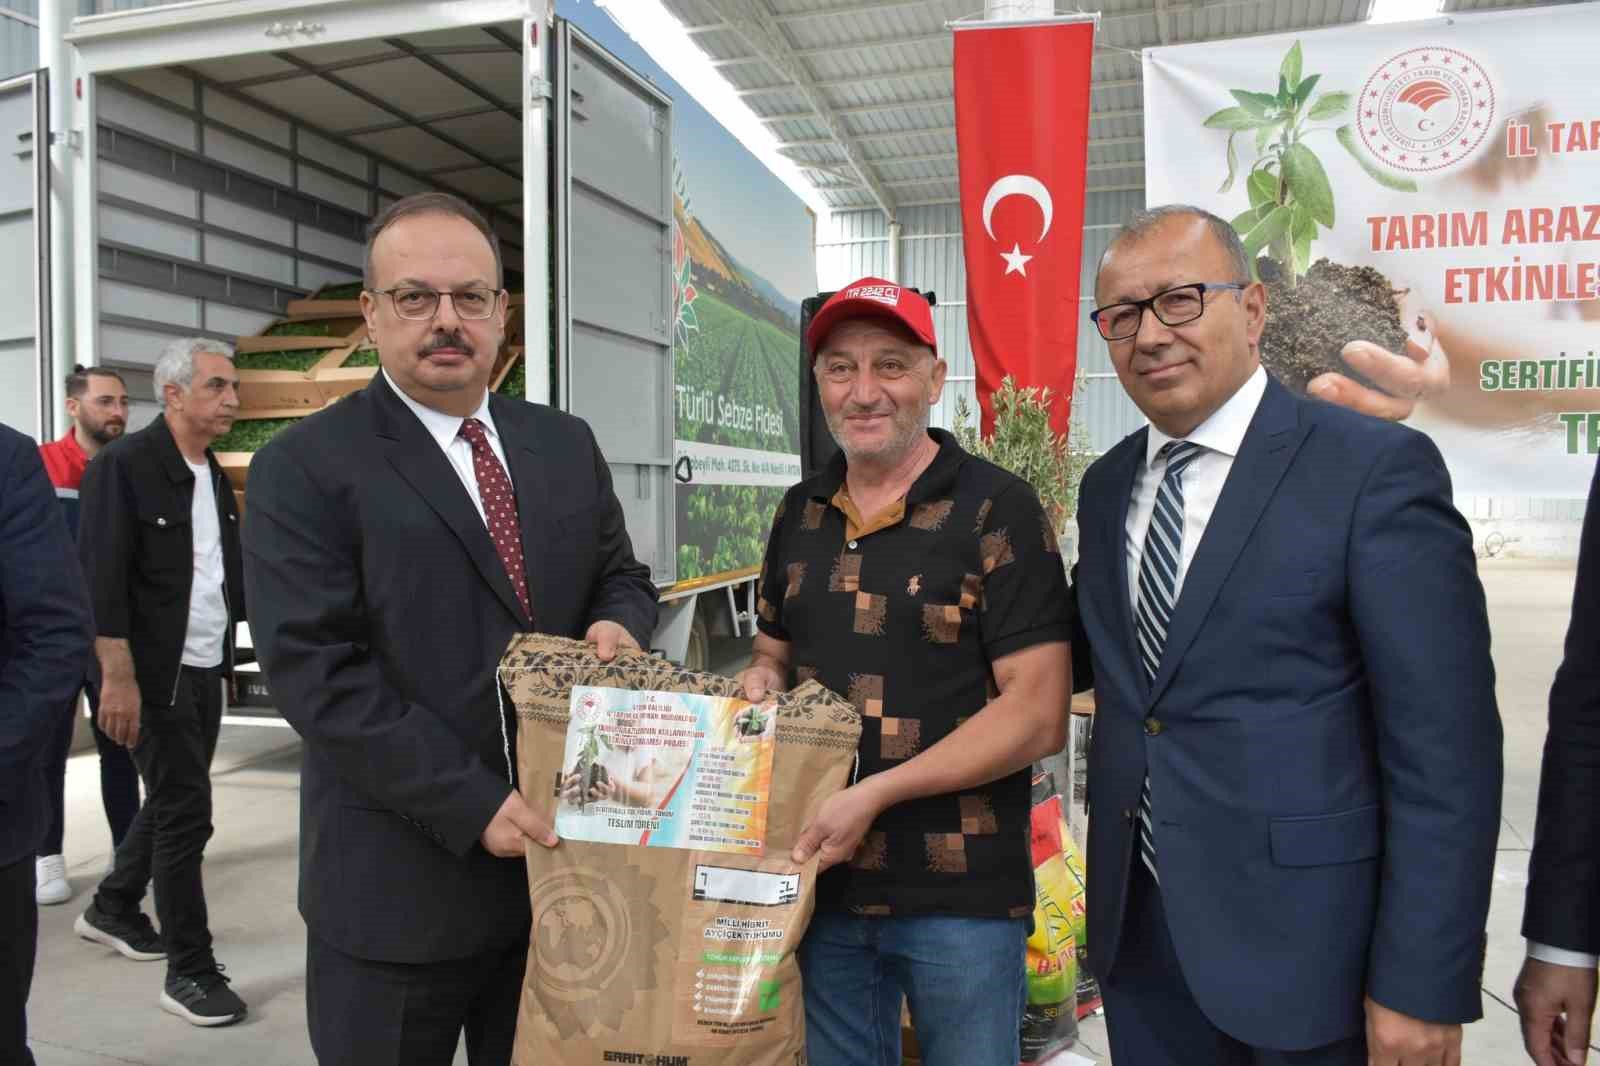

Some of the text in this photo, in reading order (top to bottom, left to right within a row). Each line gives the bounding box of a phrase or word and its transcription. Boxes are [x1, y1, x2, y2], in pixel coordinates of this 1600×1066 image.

[1507, 119, 1536, 156] İL
[1366, 211, 1488, 251] TARIM
[718, 395, 753, 431] Sebze
[755, 404, 784, 437] Fidesi
